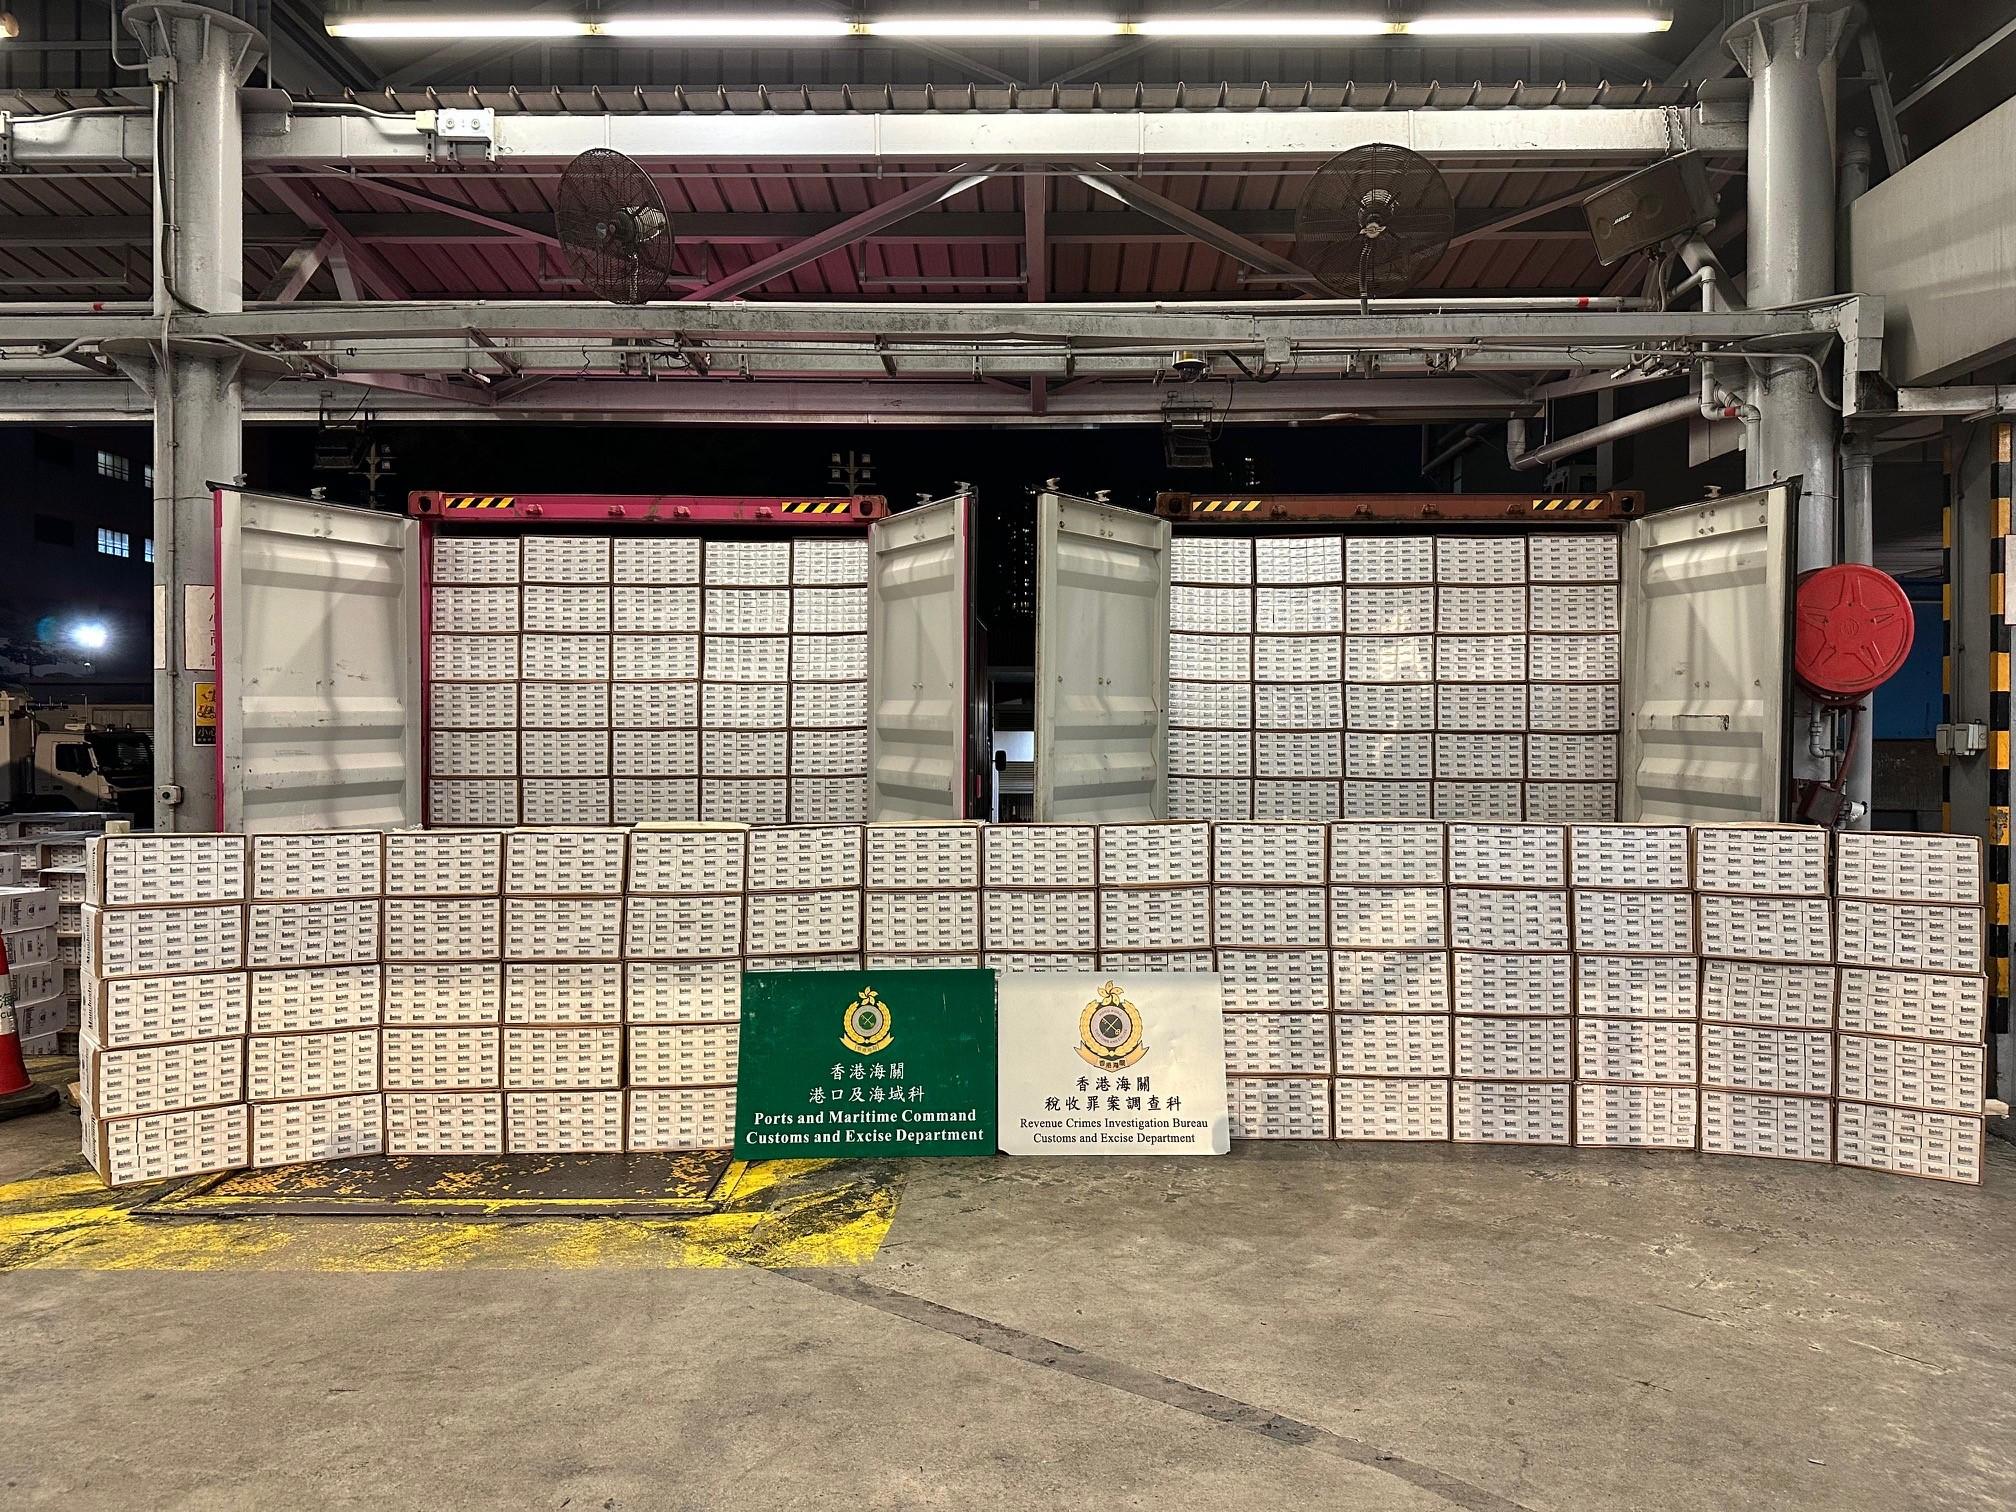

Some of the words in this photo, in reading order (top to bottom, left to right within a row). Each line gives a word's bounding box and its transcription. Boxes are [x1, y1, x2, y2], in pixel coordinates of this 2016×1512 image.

[830, 1062, 905, 1081] 香港海關
[1076, 1076, 1150, 1092] 香港海關
[809, 1085, 925, 1104] 港口及海域科
[1044, 1095, 1182, 1111] 稅收罪案調查科
[754, 1112, 793, 1125] Ports
[798, 1111, 824, 1124] and
[828, 1110, 898, 1124] Maritime
[901, 1109, 977, 1123] Command
[1020, 1118, 1063, 1128] Revenue
[1066, 1118, 1102, 1128] Crimes
[1104, 1117, 1170, 1131] Investigation
[1173, 1118, 1208, 1128] Bureau
[745, 1131, 809, 1145] Customs
[814, 1130, 840, 1143] and
[845, 1129, 892, 1142] Excise
[895, 1129, 984, 1145] Department
[1033, 1133, 1077, 1143] Customs
[1080, 1133, 1098, 1143] and
[1100, 1133, 1134, 1143] Excise
[1137, 1132, 1195, 1146] Department
